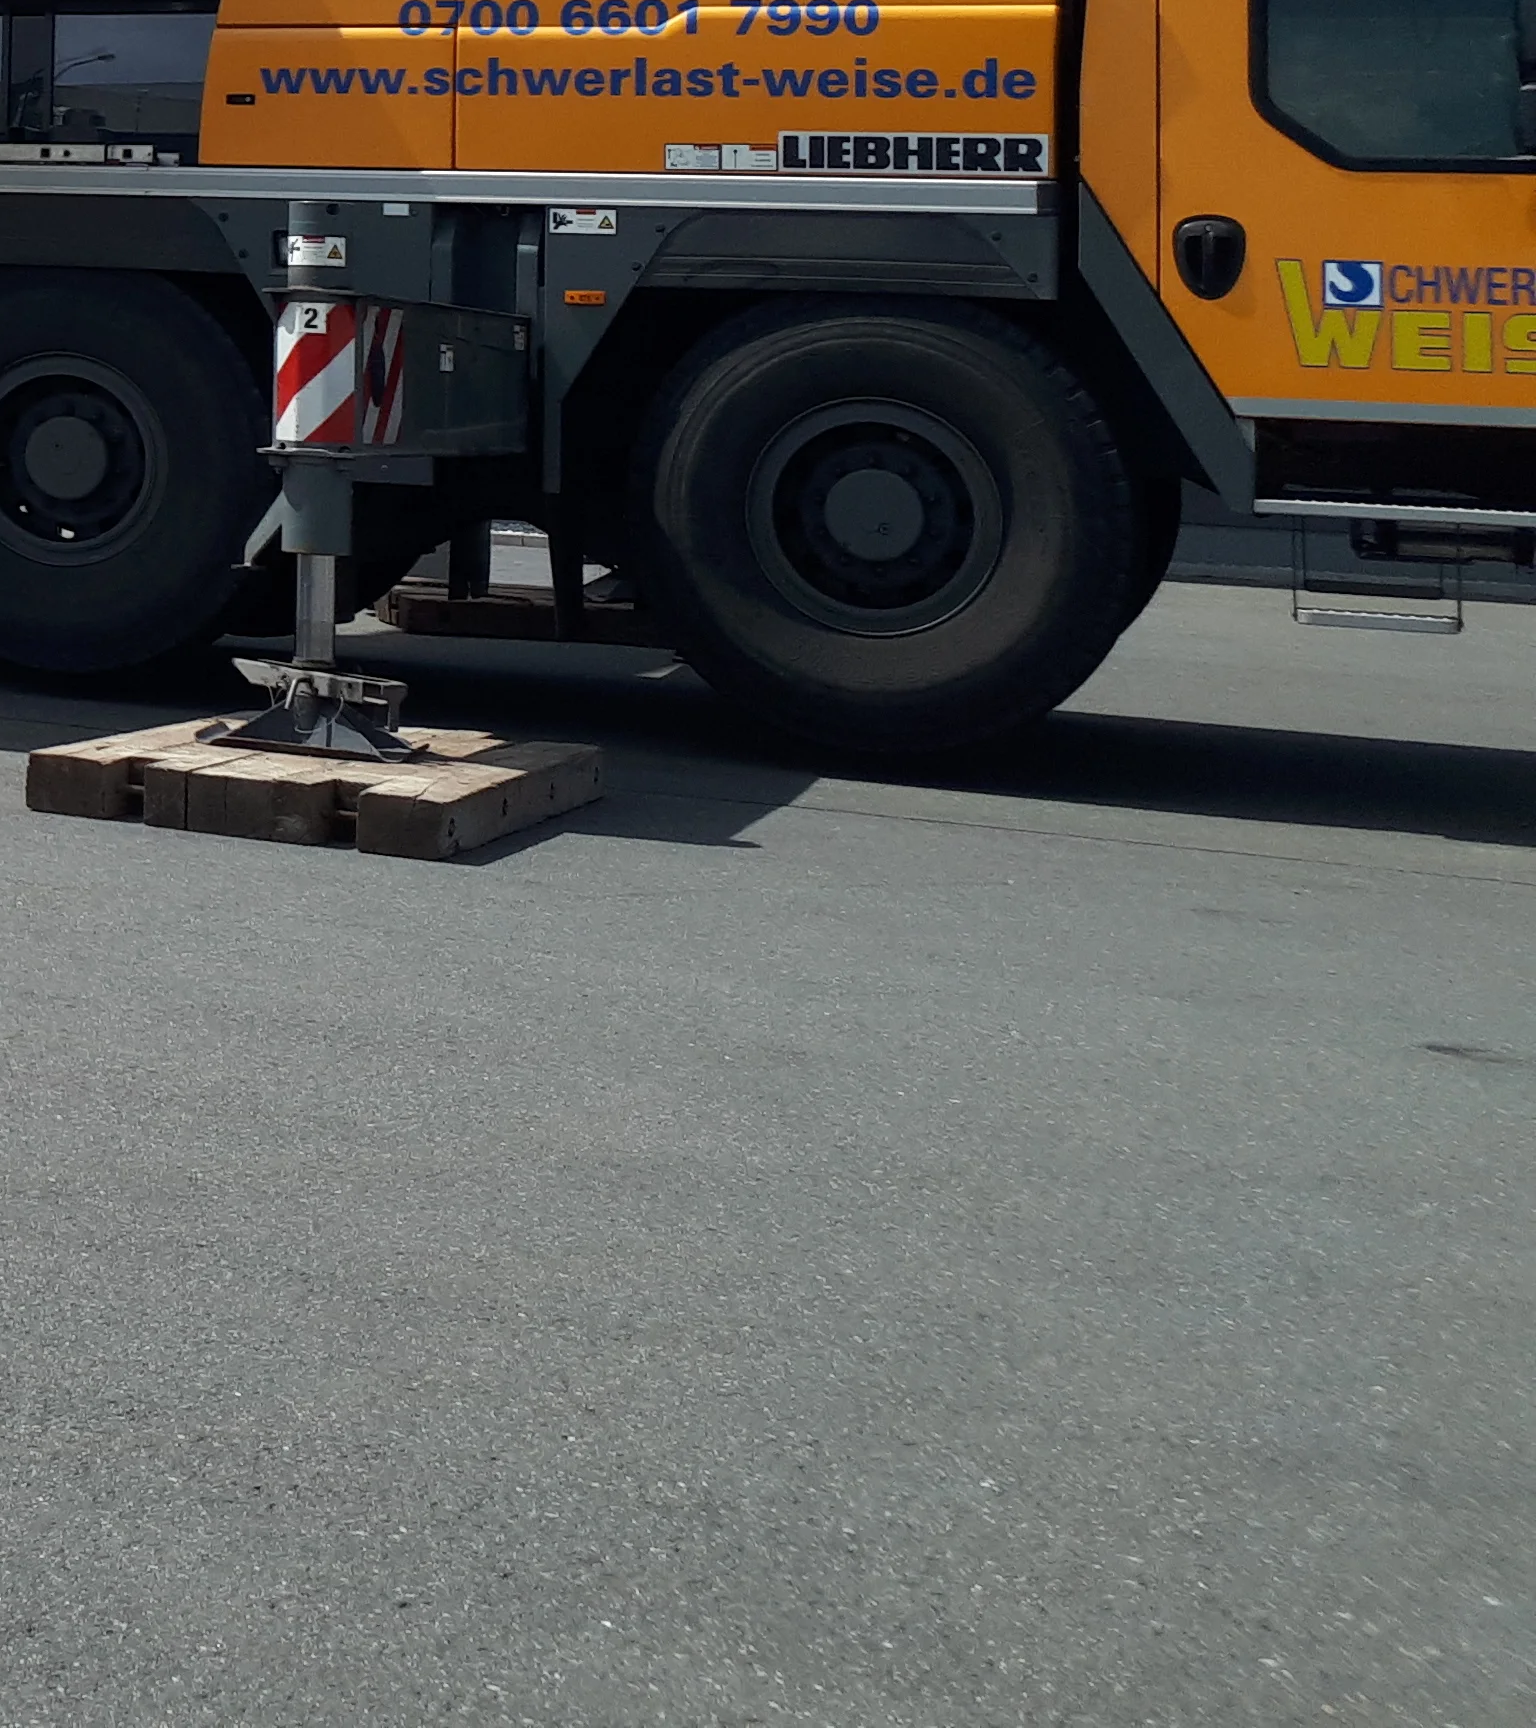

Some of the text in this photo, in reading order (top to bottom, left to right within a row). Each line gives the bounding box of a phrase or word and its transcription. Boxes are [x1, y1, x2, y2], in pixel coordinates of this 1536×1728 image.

[398, 0, 540, 36] 0700
[260, 56, 1037, 100] www.schwerlast-weise.de
[782, 135, 1044, 172] LIEBHERR
[303, 307, 319, 330] 2
